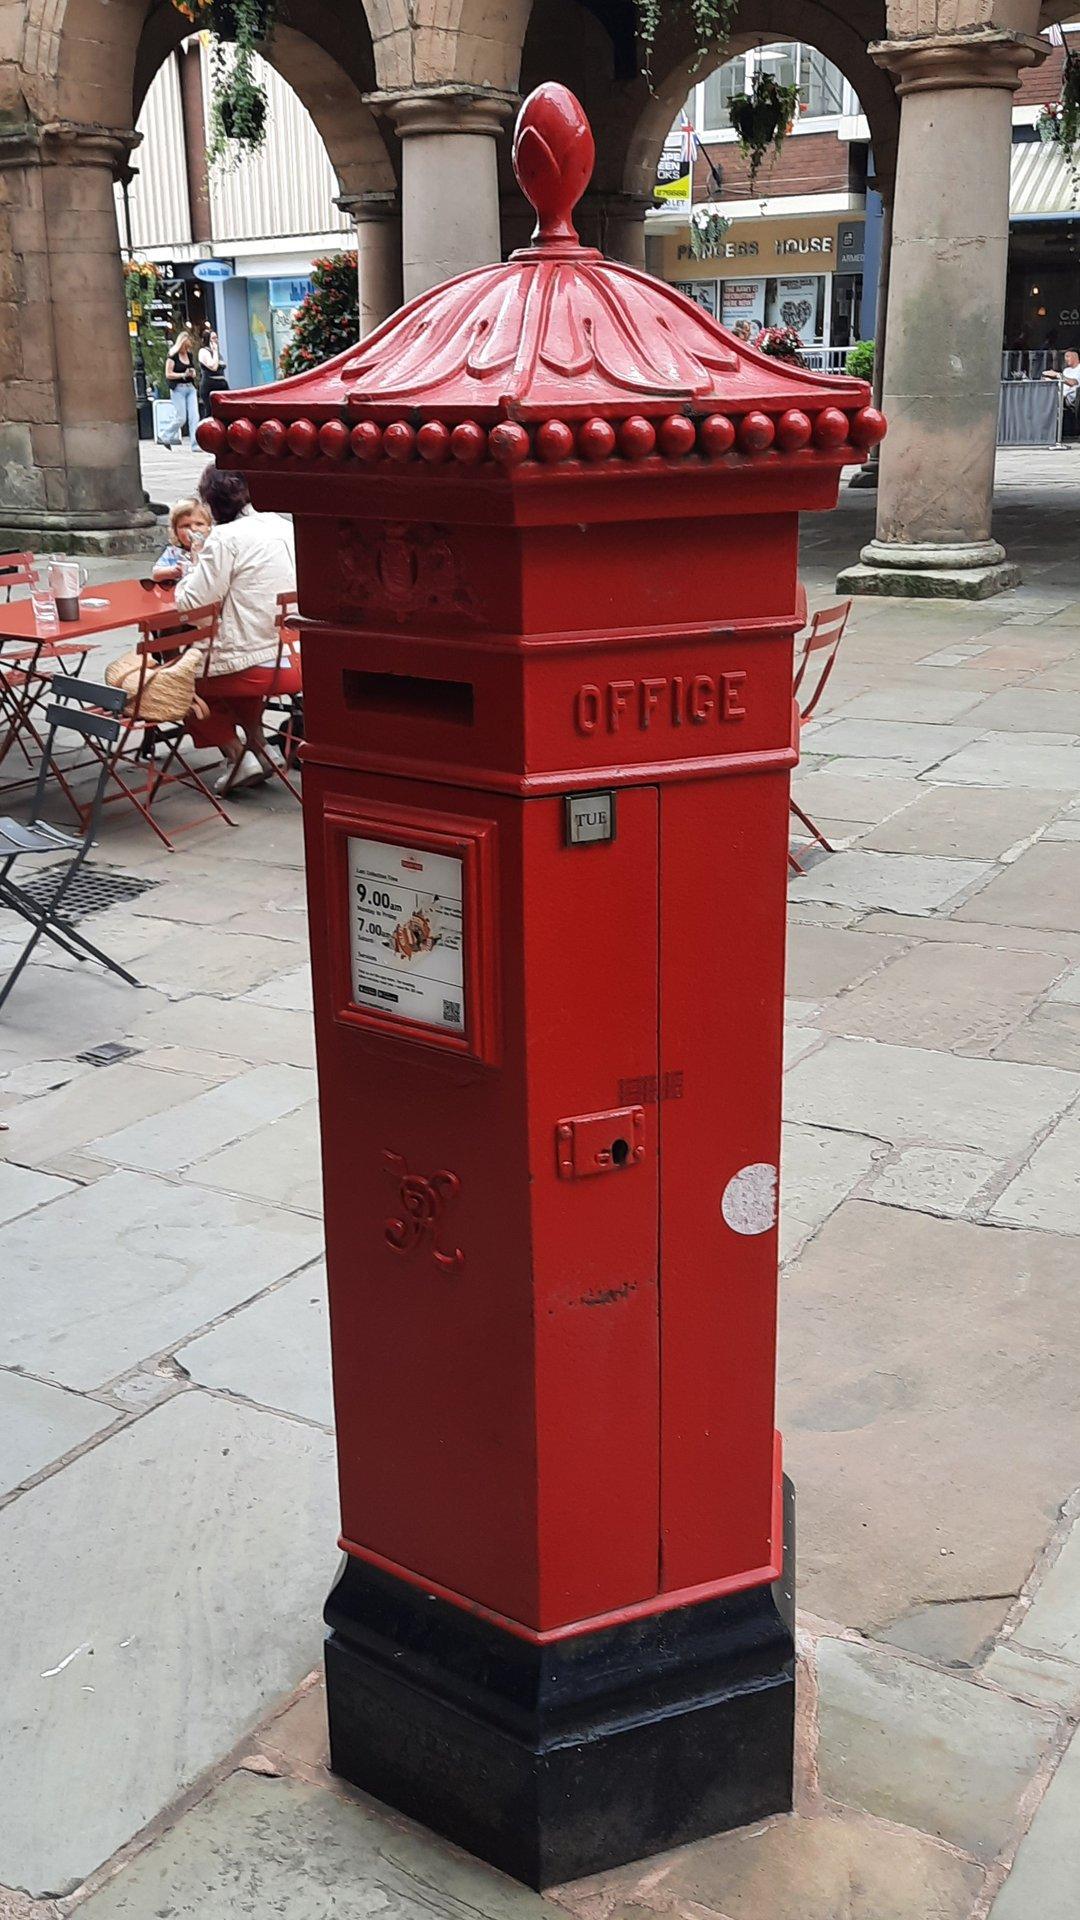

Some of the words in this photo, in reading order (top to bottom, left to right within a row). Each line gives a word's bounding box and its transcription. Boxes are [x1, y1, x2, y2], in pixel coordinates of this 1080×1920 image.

[775, 236, 833, 255] HOUSE
[574, 670, 747, 735] OFFICE
[574, 812, 607, 826] TUE
